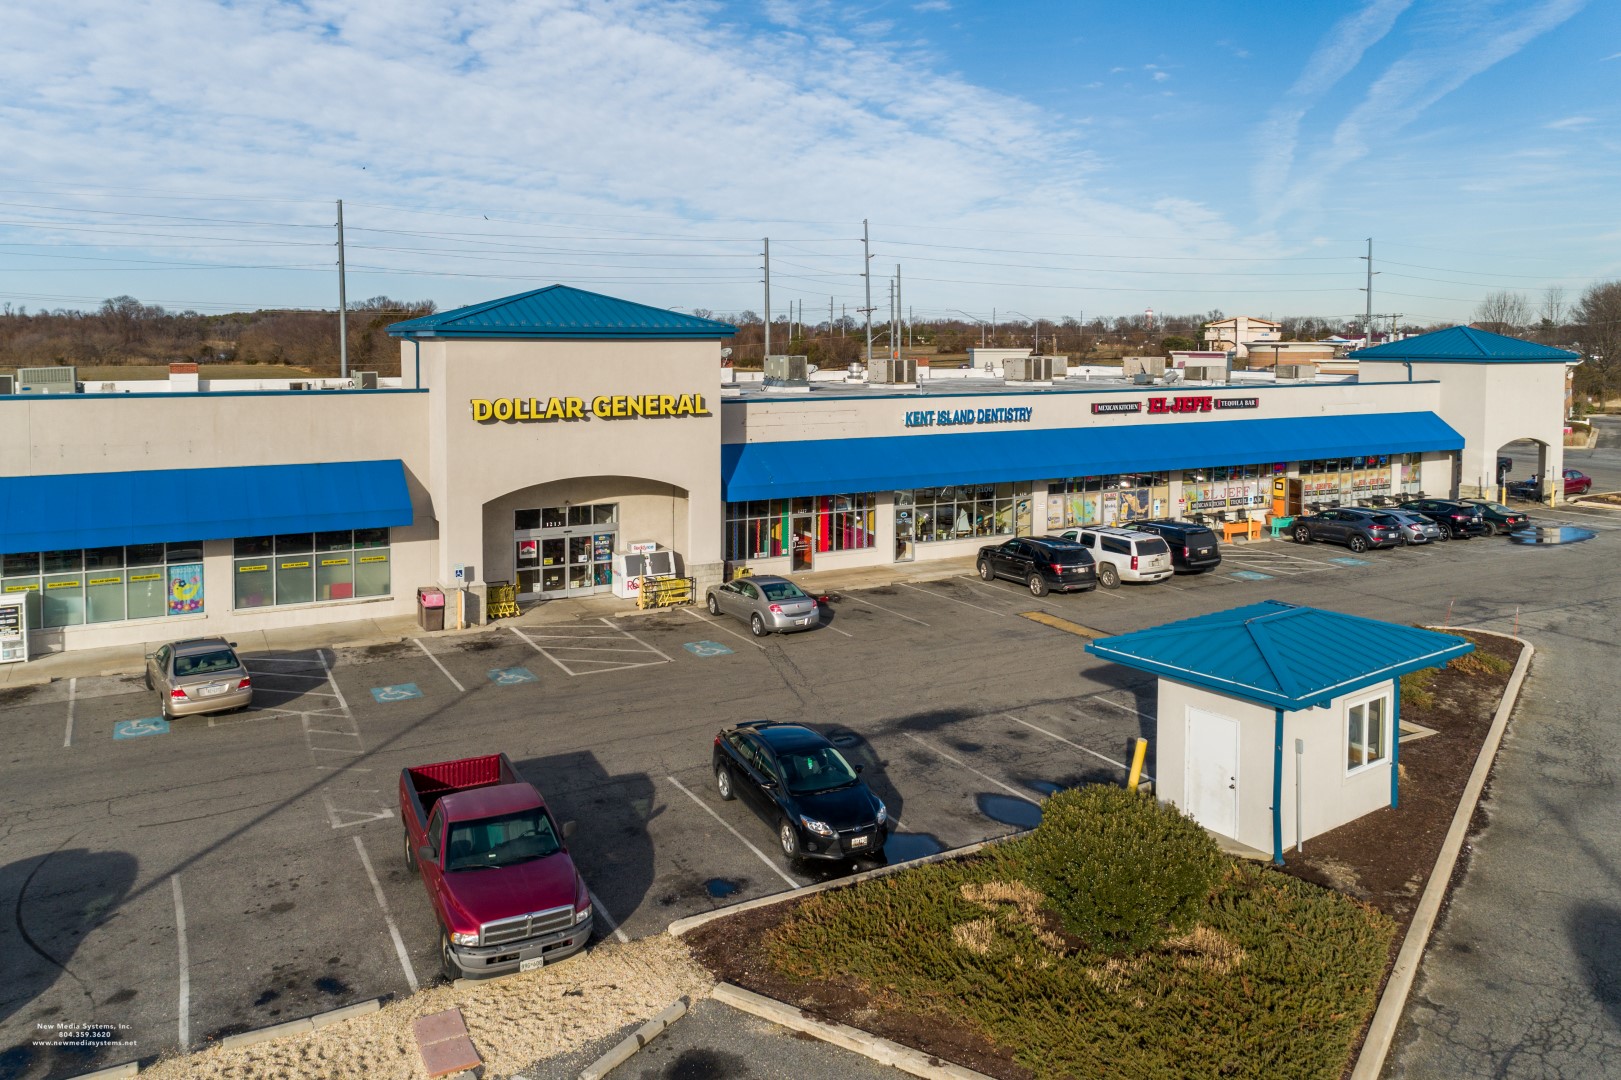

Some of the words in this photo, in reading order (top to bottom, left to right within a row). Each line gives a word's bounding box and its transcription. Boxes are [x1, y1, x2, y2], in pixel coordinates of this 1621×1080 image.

[471, 397, 585, 422] DOLLAR
[592, 393, 709, 418] GENERAL
[1098, 404, 1118, 412] MEXICAN
[1118, 403, 1139, 411] KITCHEN
[1148, 397, 1170, 414] EL
[1171, 396, 1213, 413] JEFE
[905, 410, 935, 426] KENT
[937, 409, 975, 425] ISLAND
[976, 407, 1033, 423] DENTISTRY
[1203, 489, 1218, 500] EL
[1220, 486, 1250, 498] JEFE
